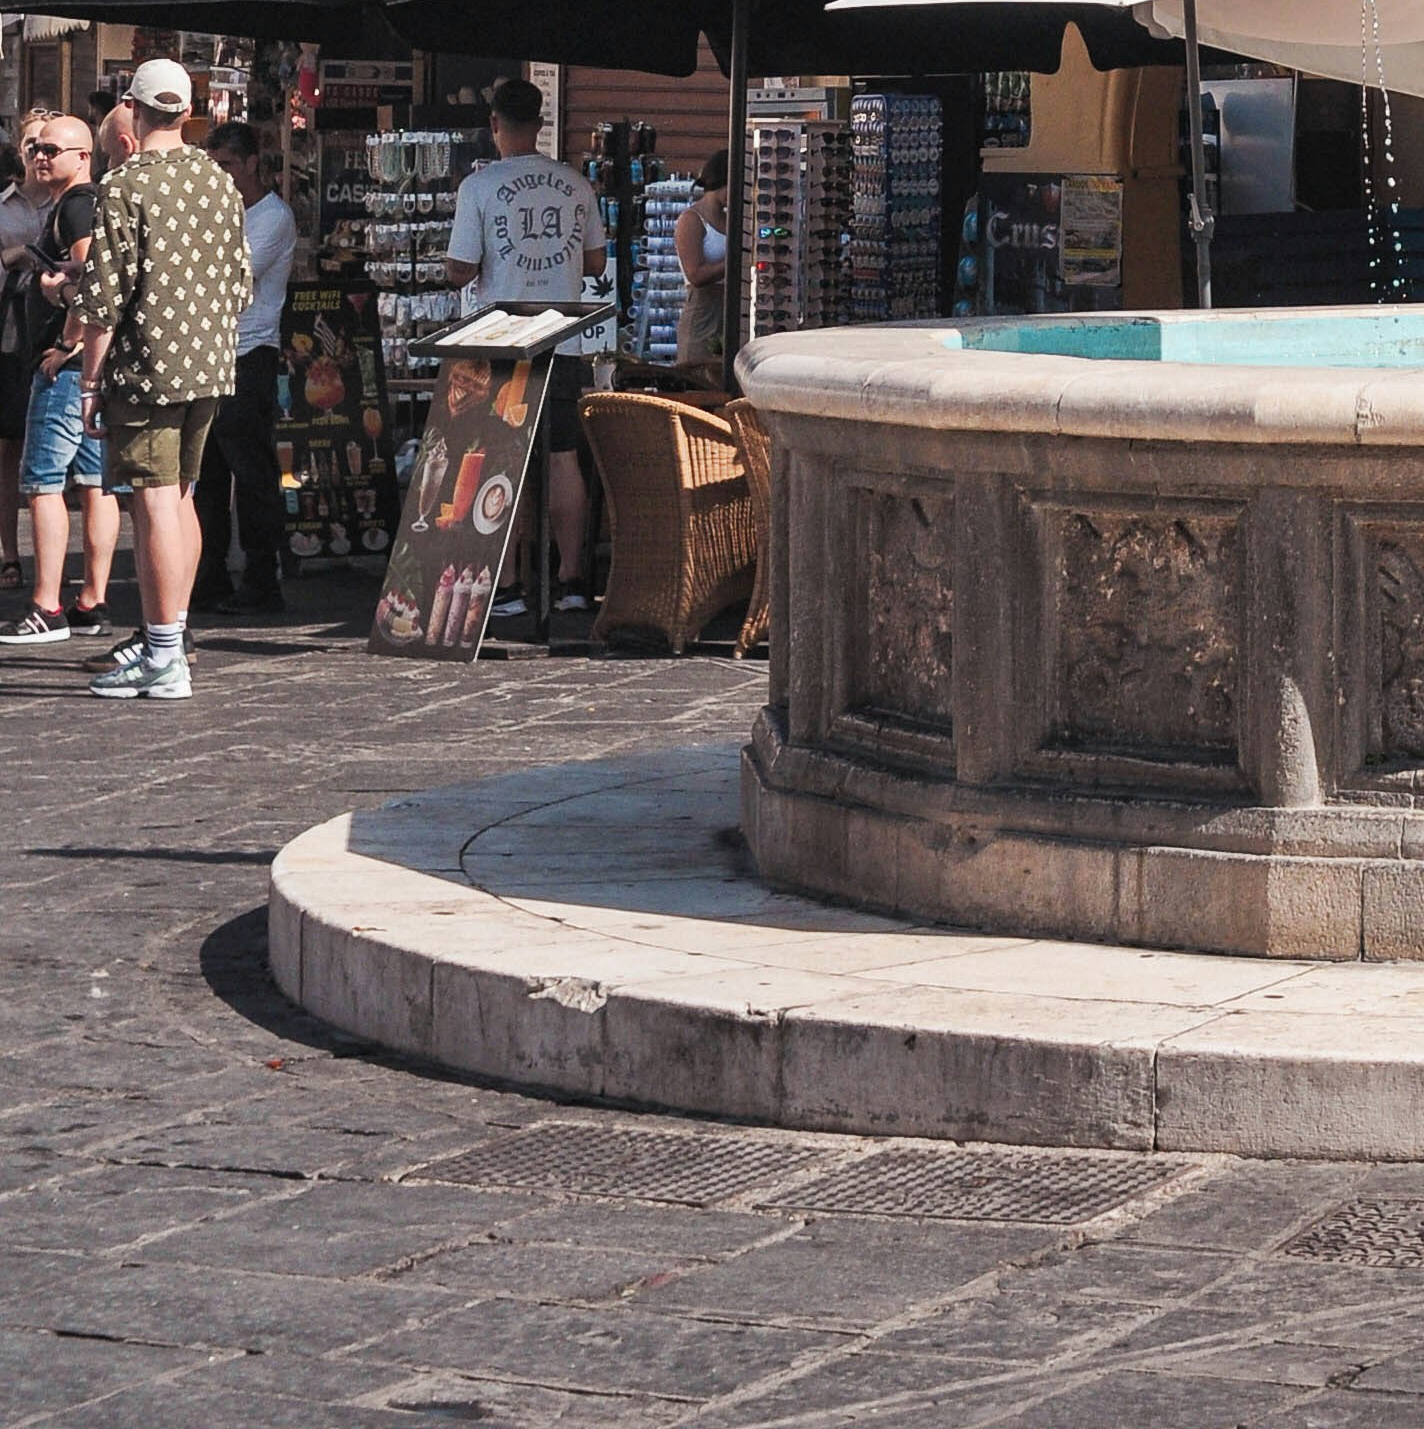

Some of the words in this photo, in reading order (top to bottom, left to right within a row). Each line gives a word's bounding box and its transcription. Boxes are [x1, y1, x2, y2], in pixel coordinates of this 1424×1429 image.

[497, 173, 576, 204] Angeles
[518, 206, 564, 241] LA
[292, 300, 341, 311] COCKTAILS
[294, 291, 318, 302] FREE
